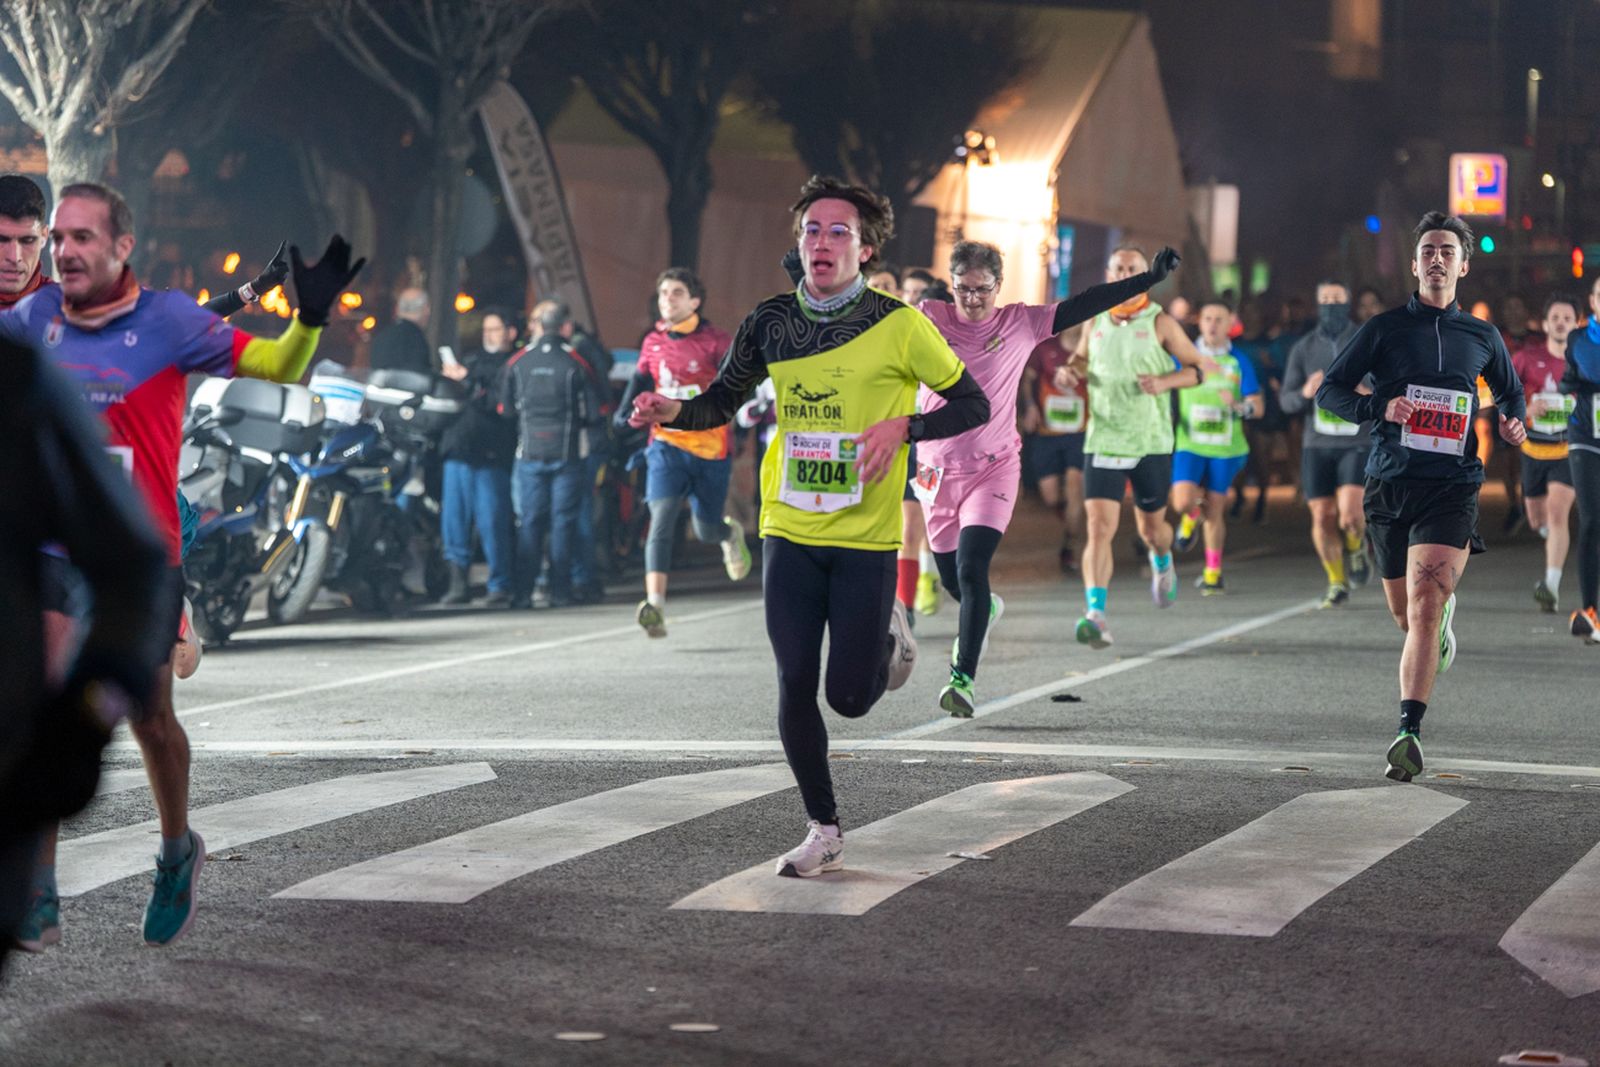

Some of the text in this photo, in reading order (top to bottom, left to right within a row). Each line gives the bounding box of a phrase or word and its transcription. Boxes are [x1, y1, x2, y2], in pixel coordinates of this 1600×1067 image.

[1443, 396, 1451, 404] DE
[1415, 409, 1462, 432] 12413
[797, 460, 848, 486] 8204
